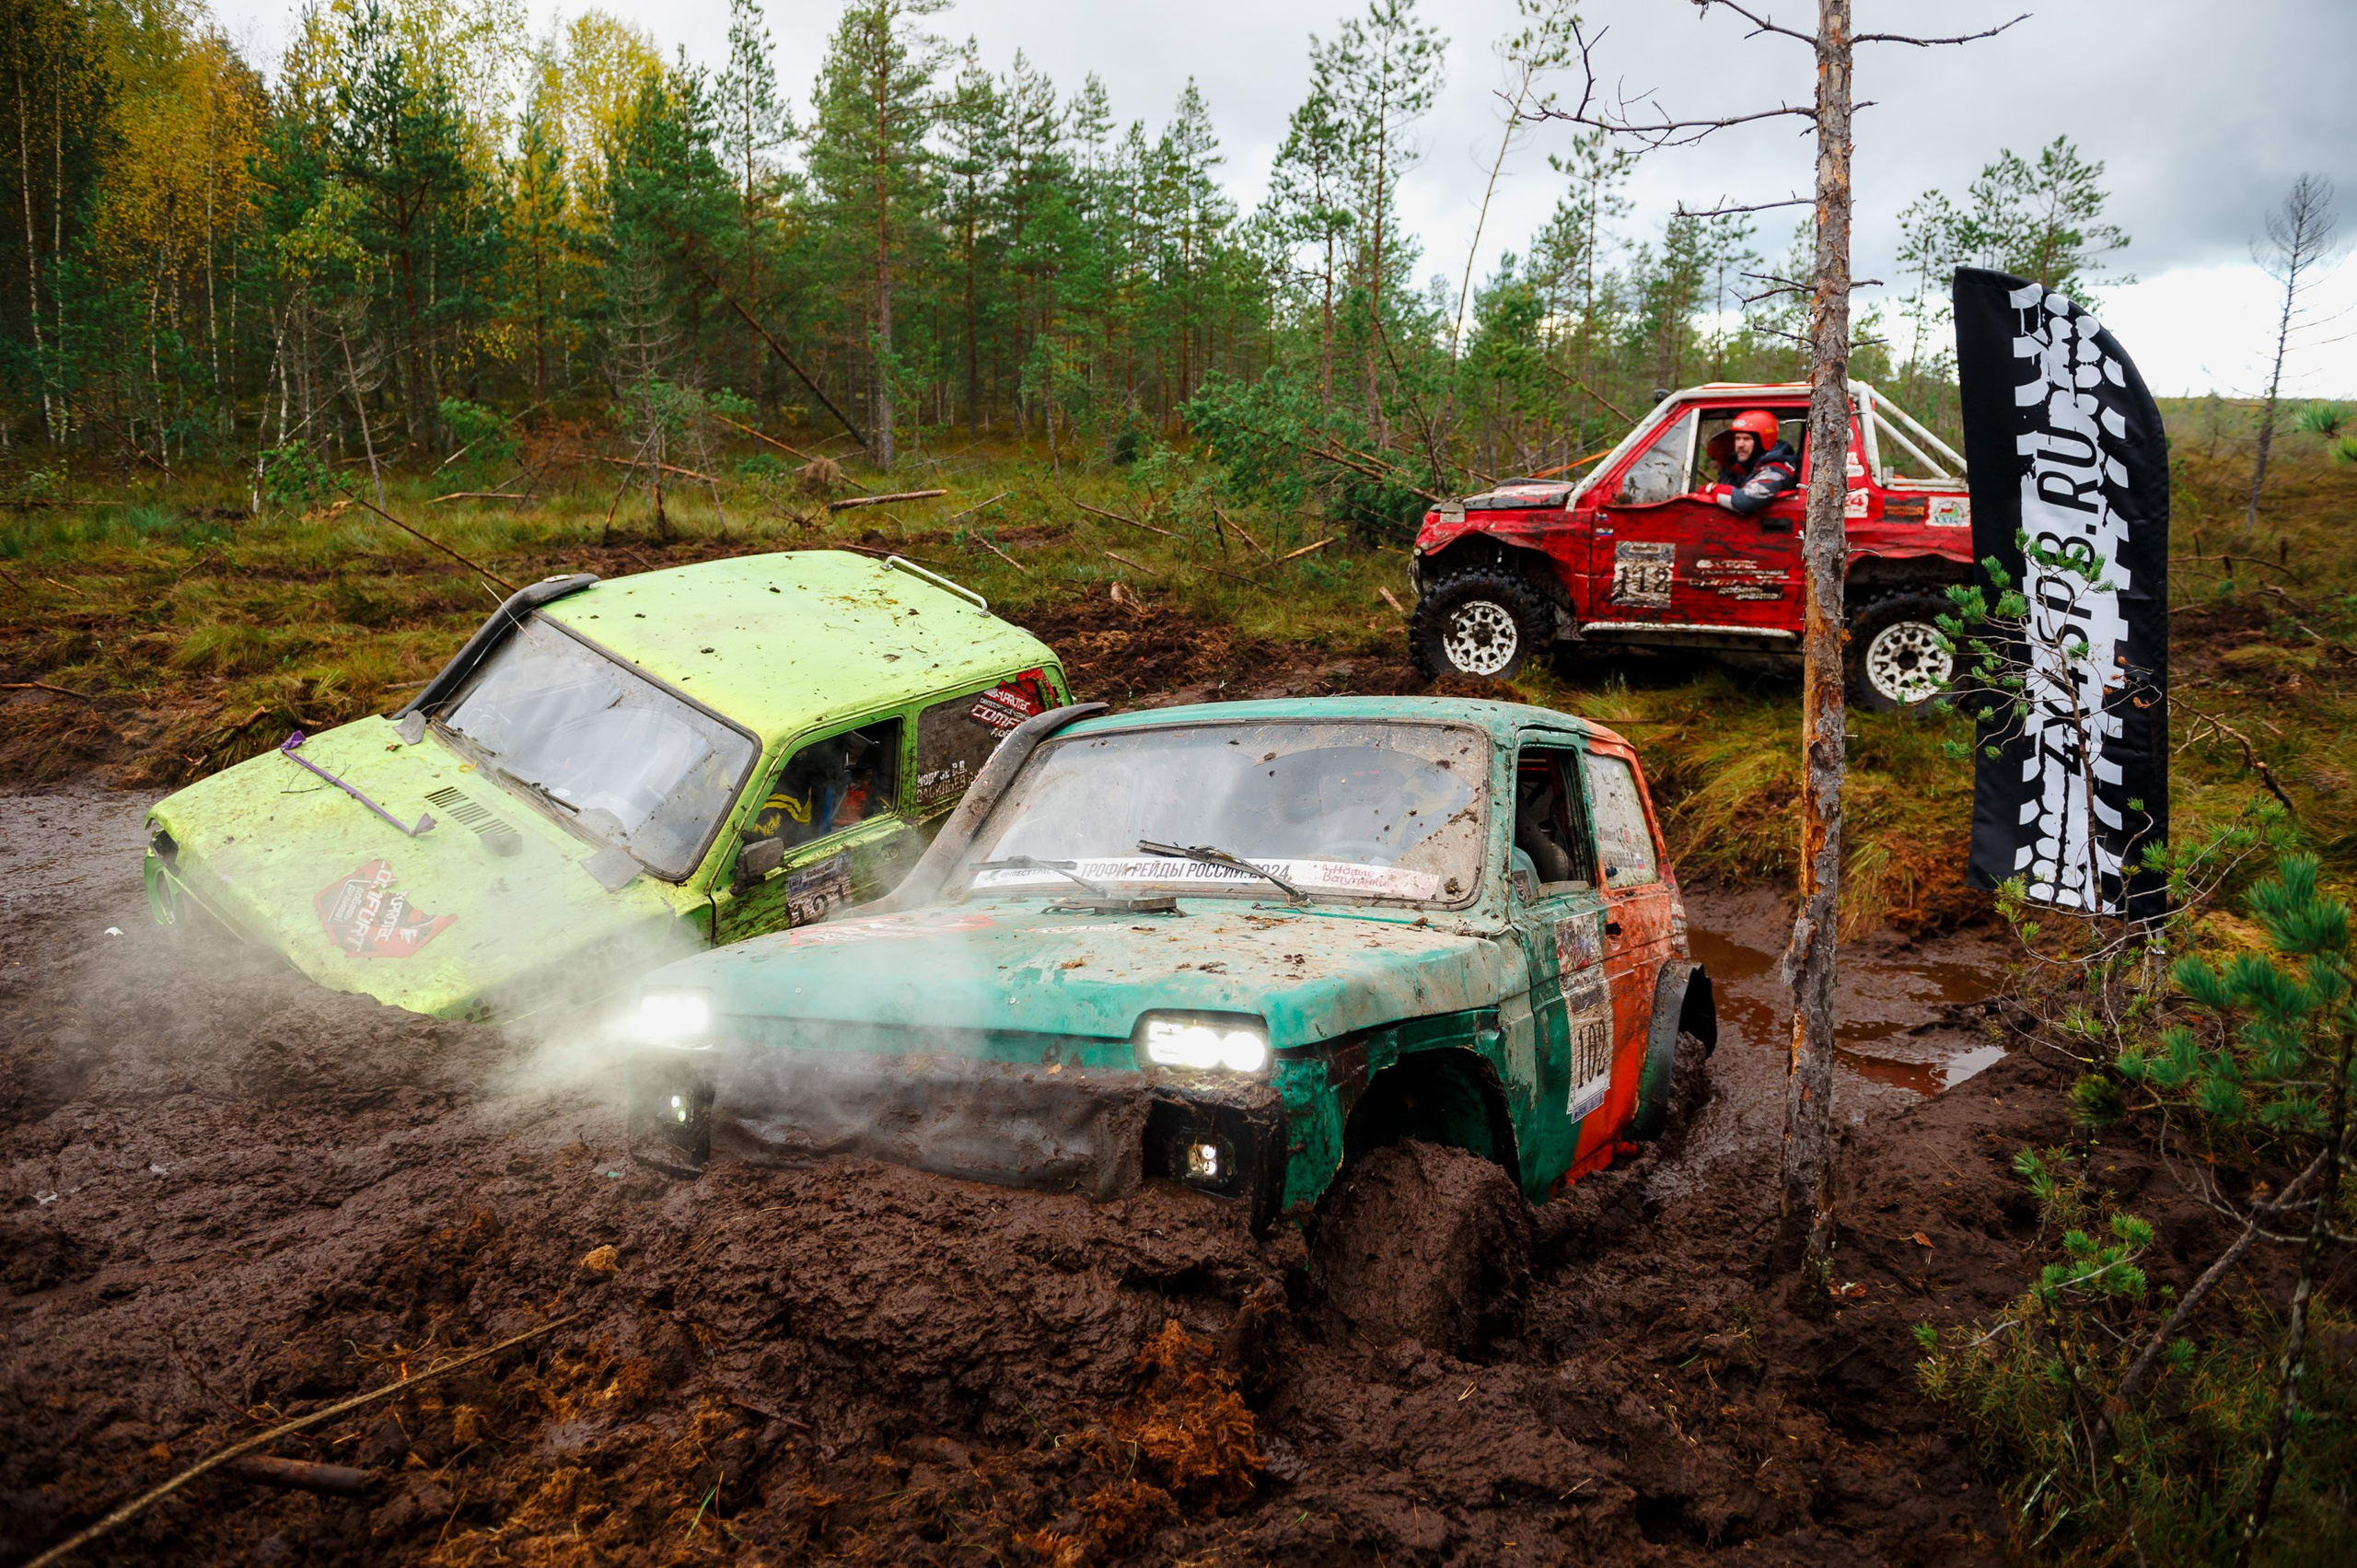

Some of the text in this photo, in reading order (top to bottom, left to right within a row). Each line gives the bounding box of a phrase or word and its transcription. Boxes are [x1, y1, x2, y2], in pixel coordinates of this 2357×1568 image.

[1618, 565, 1669, 597] 112
[2036, 425, 2099, 778] 4X4SPB.RU
[970, 703, 1022, 727] COMF
[1322, 871, 1388, 888] Ватутинки
[1577, 1018, 1607, 1089] 102
